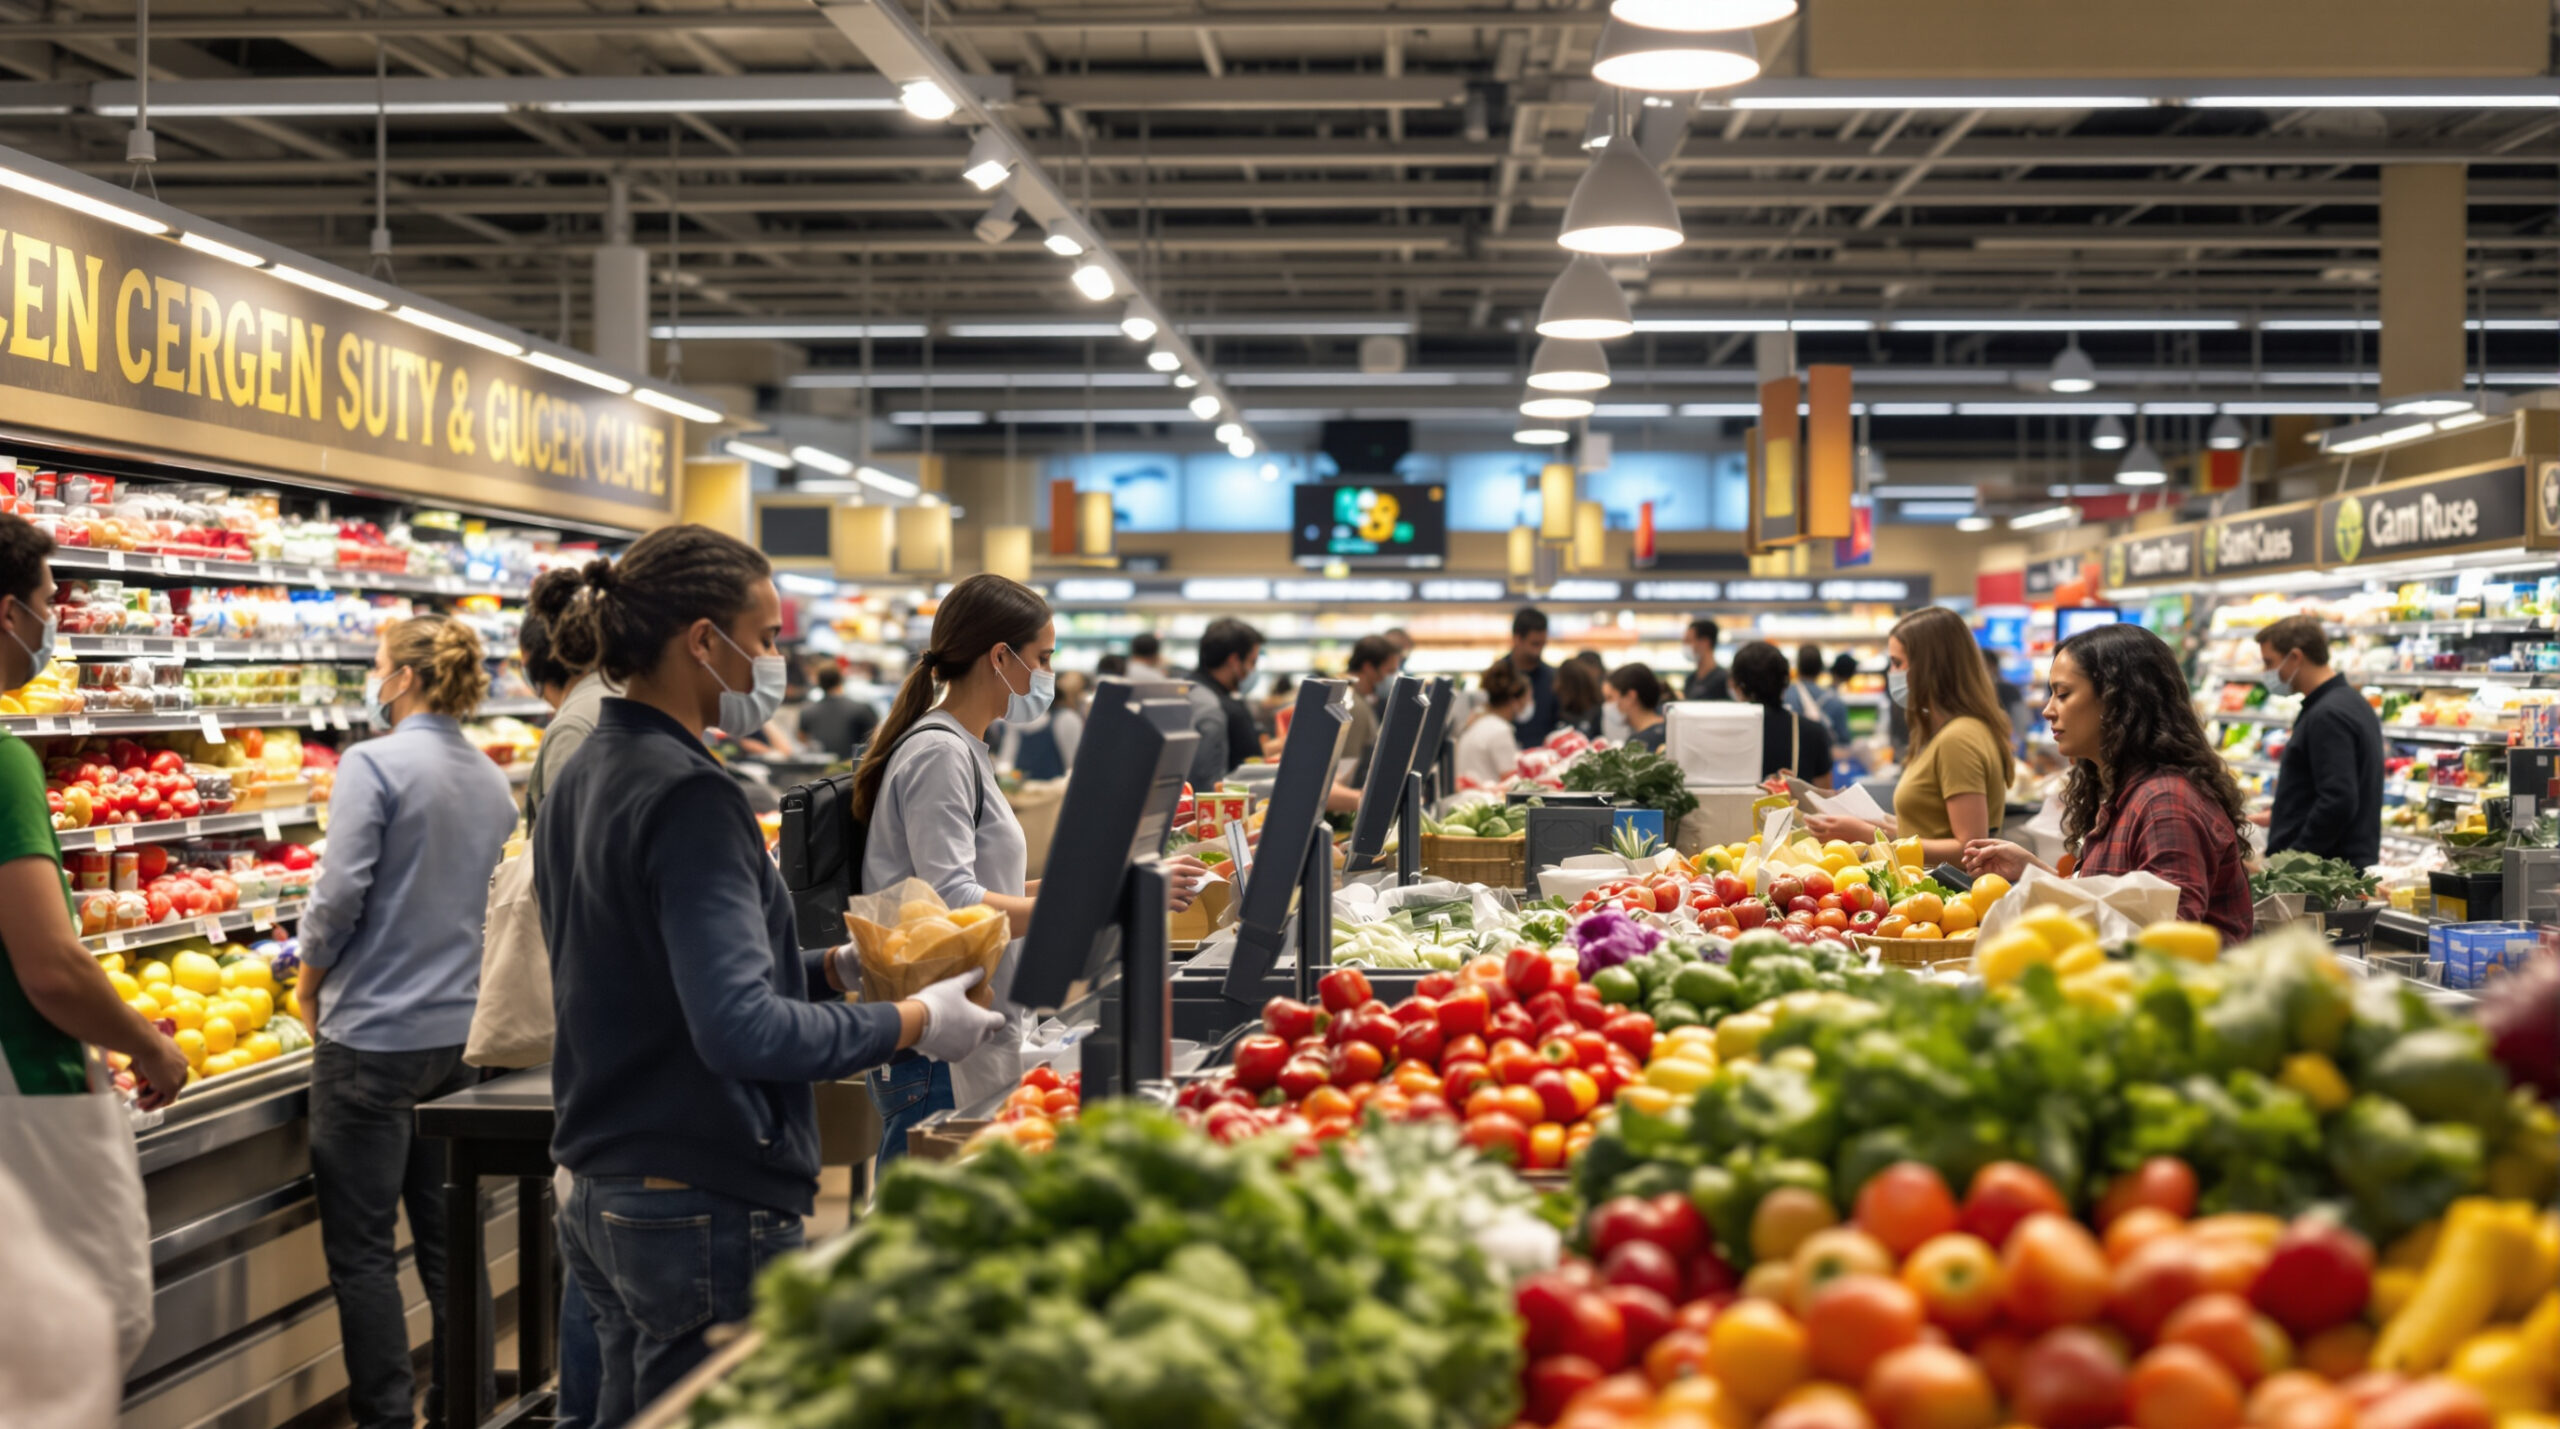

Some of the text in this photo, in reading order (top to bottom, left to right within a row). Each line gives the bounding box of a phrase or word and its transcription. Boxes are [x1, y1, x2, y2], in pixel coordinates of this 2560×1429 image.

[116, 268, 325, 421] CERGEN
[337, 332, 442, 446] SUTY
[447, 367, 475, 456] &
[486, 378, 588, 480] GUCER
[594, 413, 666, 496] CLAFE
[2421, 492, 2478, 540] Ruse
